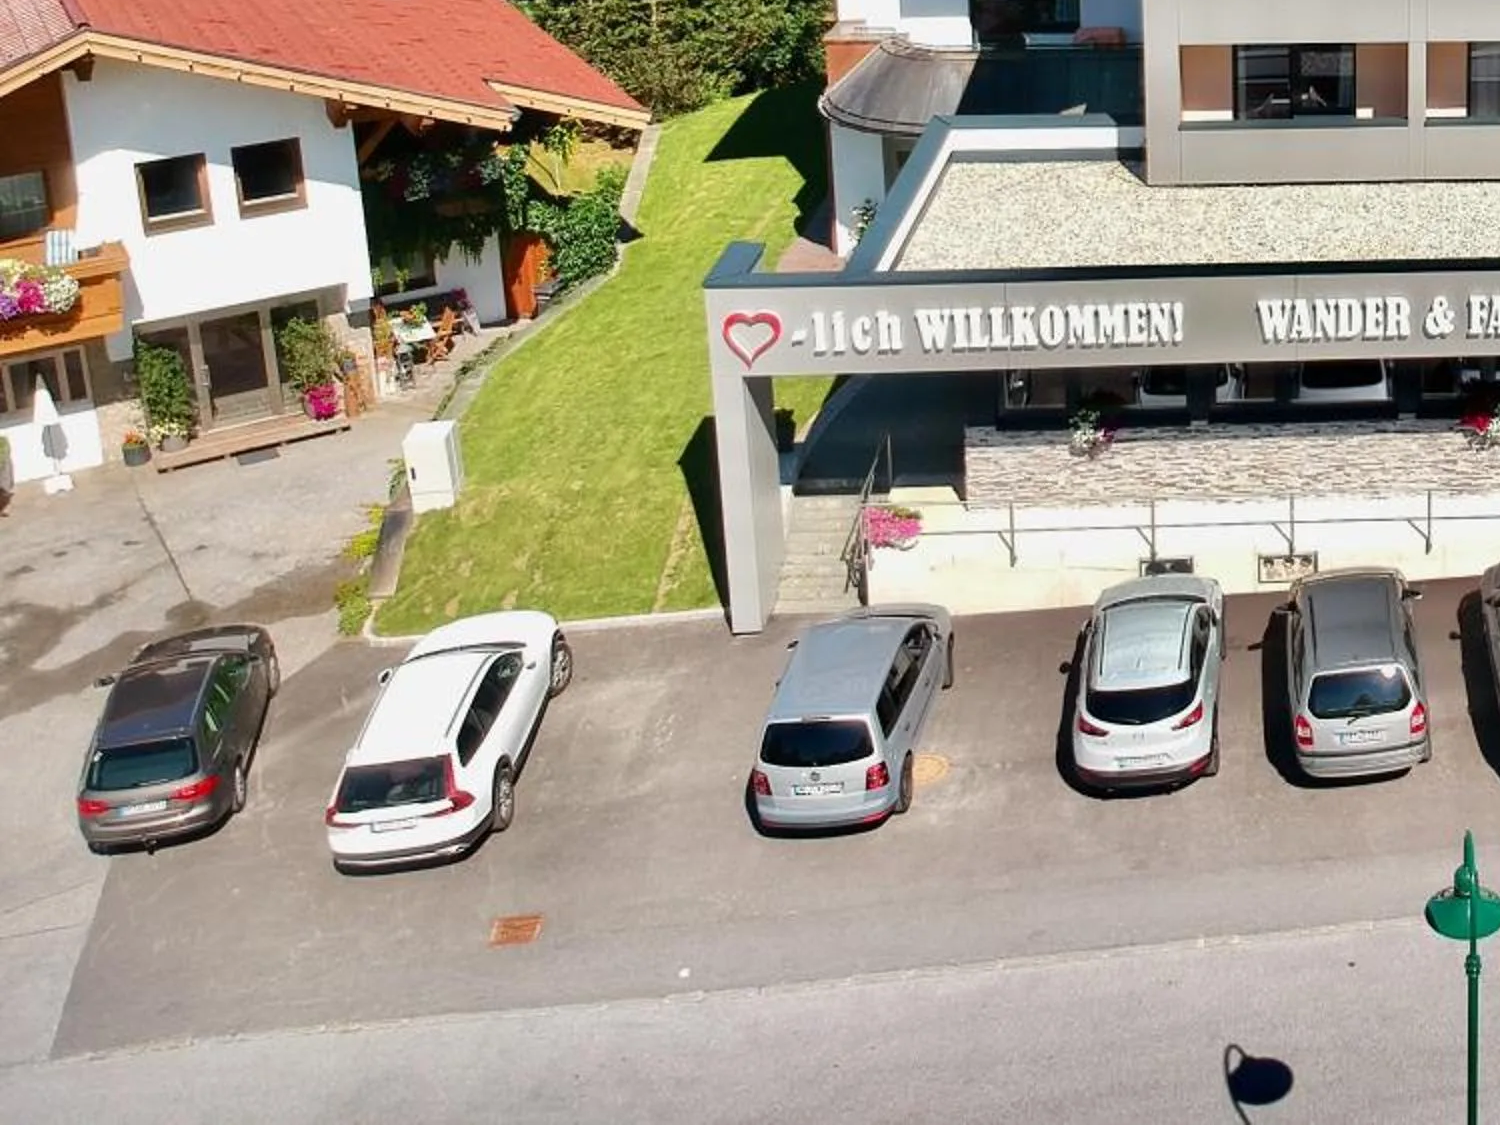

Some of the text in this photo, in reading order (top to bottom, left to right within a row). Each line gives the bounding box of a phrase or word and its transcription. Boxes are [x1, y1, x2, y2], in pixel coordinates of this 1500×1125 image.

[914, 302, 1184, 351] WILLKOMMEN!
[1257, 296, 1411, 341] WANDER
[1425, 295, 1455, 337] &
